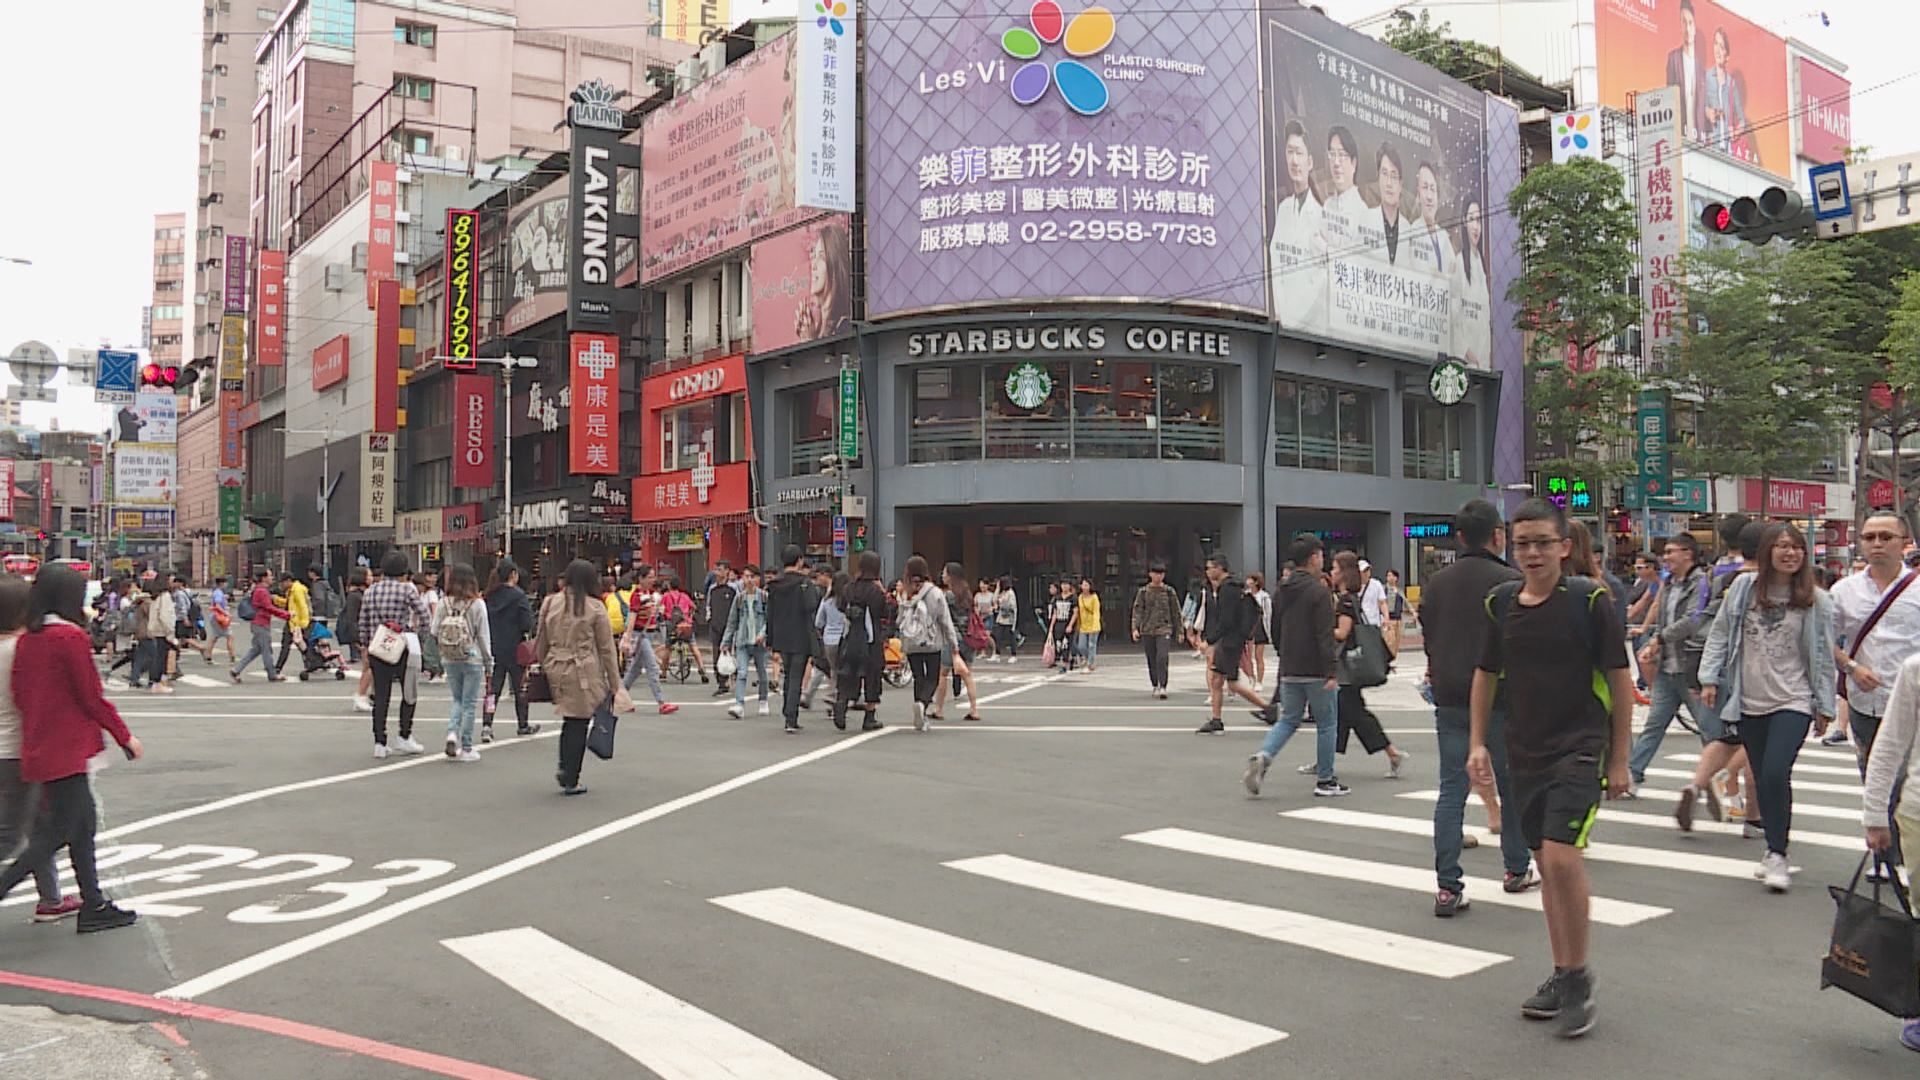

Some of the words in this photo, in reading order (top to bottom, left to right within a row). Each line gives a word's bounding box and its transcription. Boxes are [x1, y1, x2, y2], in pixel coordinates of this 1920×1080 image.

[1103, 54, 1153, 67] PLASTIC
[1155, 58, 1206, 76] SURGERY
[1103, 68, 1145, 81] CLINIC
[574, 102, 622, 129] LAKING
[822, 36, 838, 178] 樂菲整形外科診所
[919, 142, 1210, 188] 樂菲整形外科診所
[583, 146, 609, 284] LAKING
[920, 190, 1007, 221] 整形美容
[1022, 186, 1118, 212] 醫美微整
[1132, 188, 1216, 217] 光療雷射
[919, 221, 1010, 252] 服務專線
[1021, 220, 1217, 246] 02-2958-7733
[451, 215, 473, 363] 89641999
[1333, 256, 1449, 315] 樂菲整形外科診所
[1369, 300, 1416, 328] AESTHETIC
[1418, 312, 1448, 335] CLINIC
[908, 327, 1105, 357] STARBUCKS
[1126, 327, 1230, 356] COFFEE
[669, 367, 725, 400] COSMED
[466, 394, 484, 466] BESO
[585, 384, 608, 468] 康是美
[371, 456, 385, 524] 阿瘦皮鞋
[655, 482, 690, 509] 康是美
[778, 486, 820, 501] STARBUCKS
[512, 498, 569, 530] LAKING
